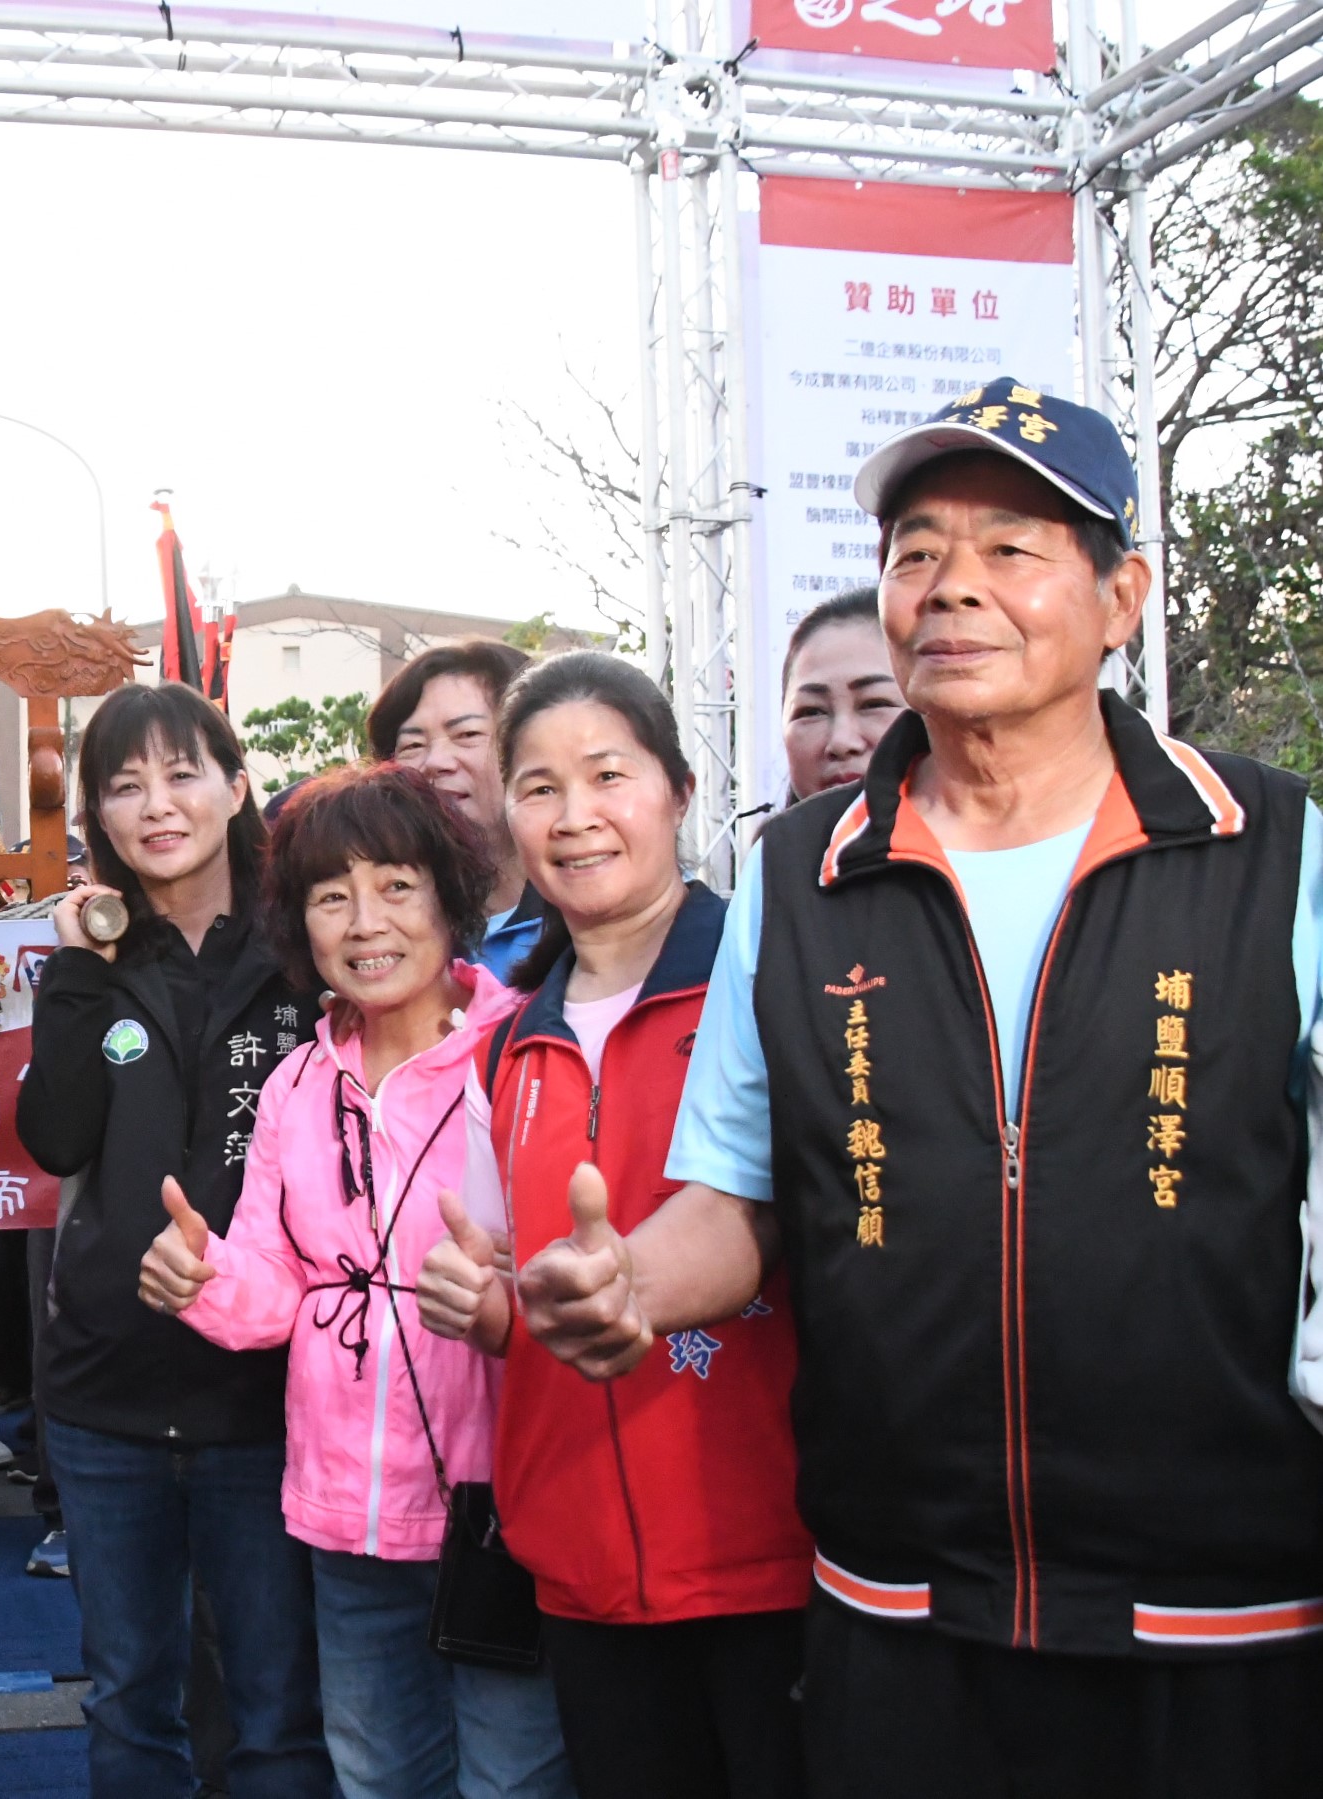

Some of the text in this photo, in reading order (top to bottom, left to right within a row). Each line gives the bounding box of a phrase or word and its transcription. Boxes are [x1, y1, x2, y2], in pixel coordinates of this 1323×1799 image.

[843, 1000, 871, 1106] 主任委員
[1146, 969, 1195, 1210] 埔鹽順澤宮
